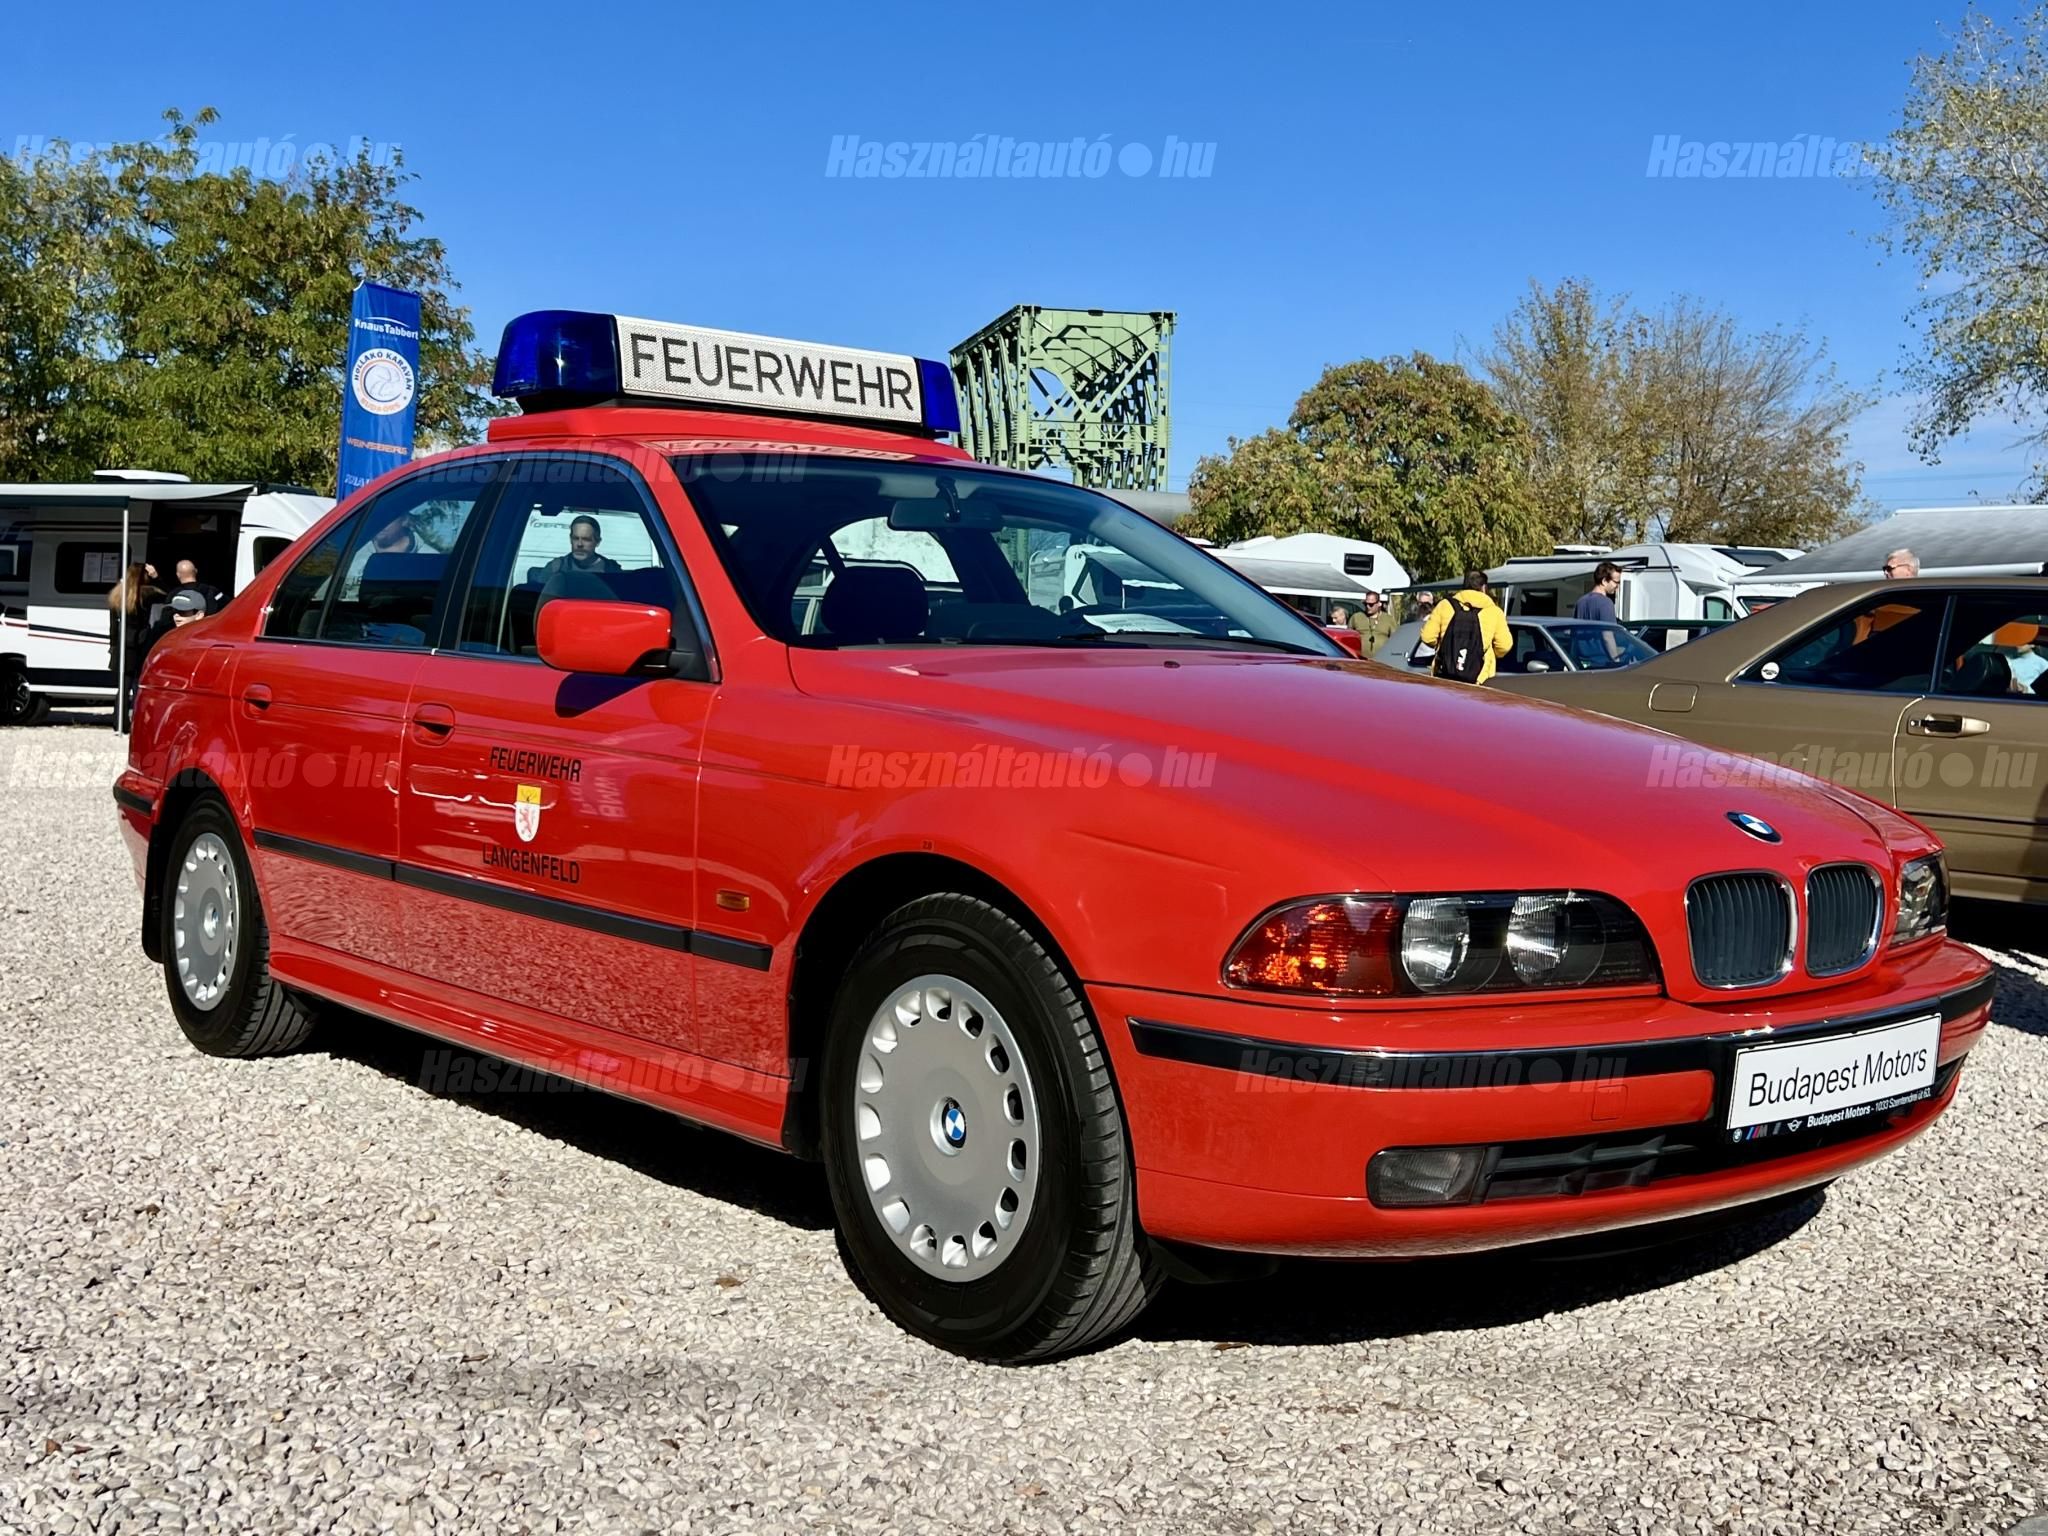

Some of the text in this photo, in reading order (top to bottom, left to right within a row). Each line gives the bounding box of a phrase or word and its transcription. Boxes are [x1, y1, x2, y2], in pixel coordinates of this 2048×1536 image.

[354, 318, 419, 340] KnausTabbert
[630, 333, 914, 411] FEUERWEHR
[490, 747, 582, 782] FEUERWEHR
[482, 843, 580, 884] LANGENFELD
[1749, 1048, 1927, 1107] Budapest Motors
[1807, 1110, 1844, 1128] Budapest
[1845, 1105, 1870, 1119] Motors
